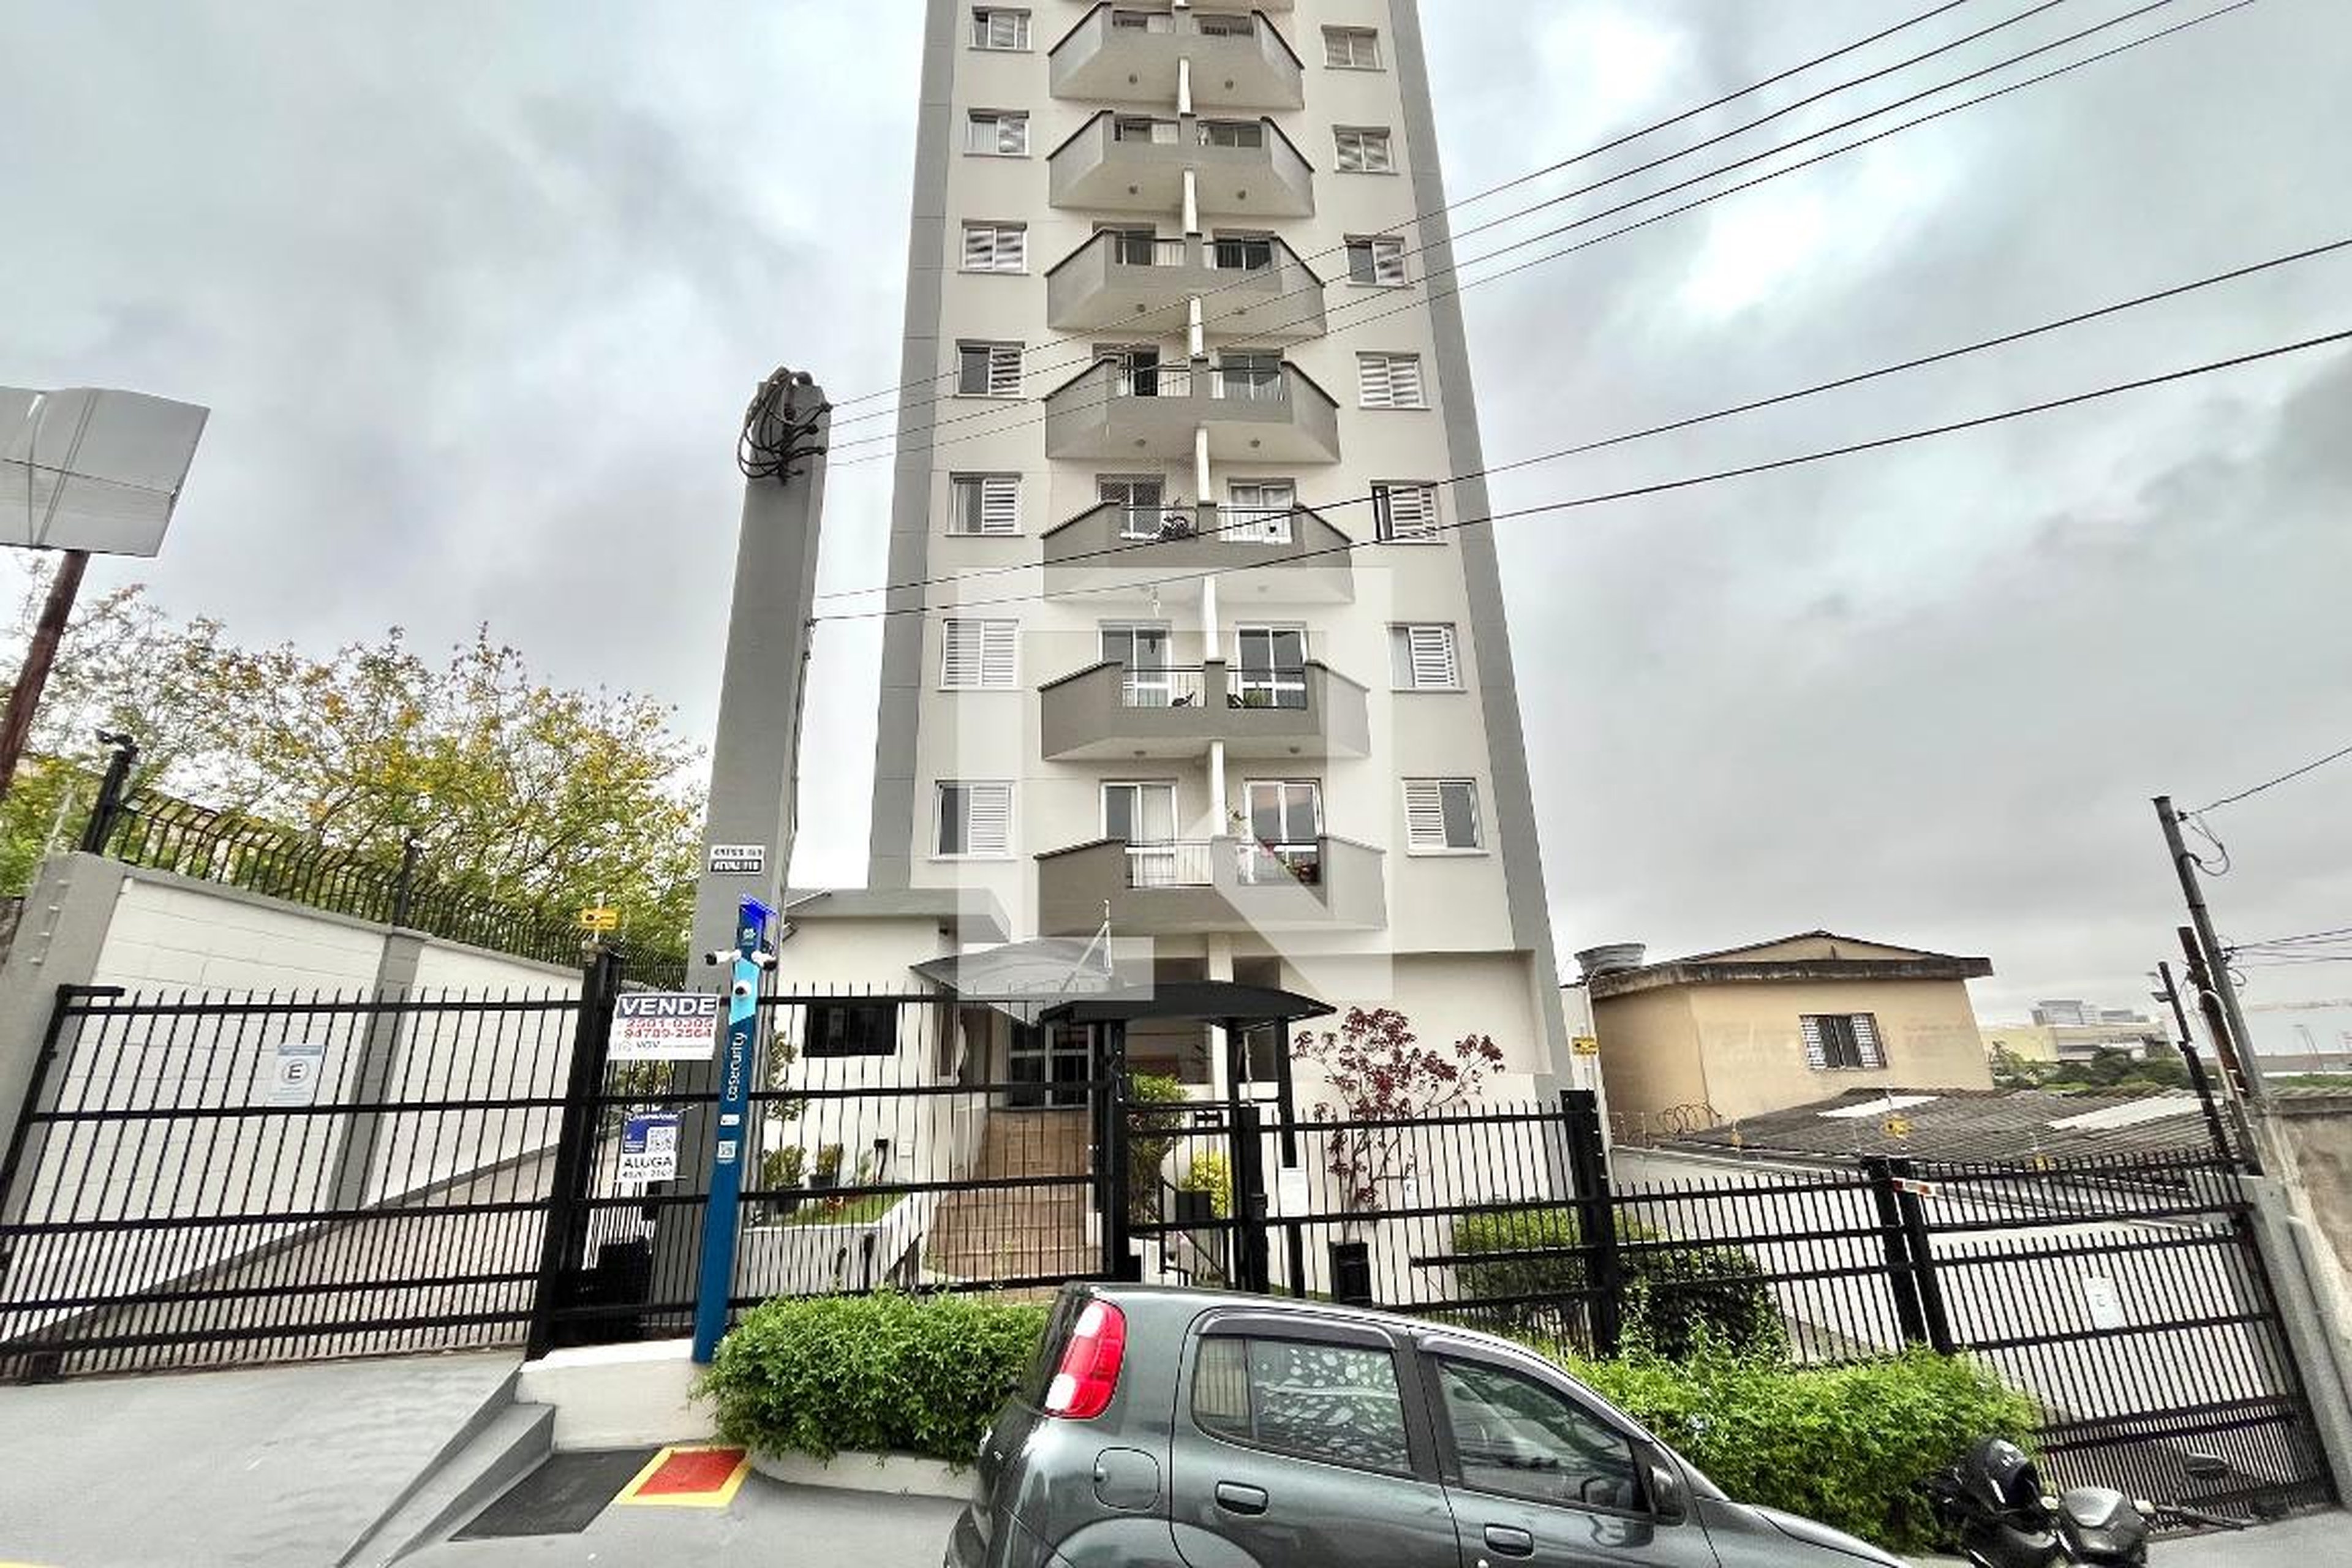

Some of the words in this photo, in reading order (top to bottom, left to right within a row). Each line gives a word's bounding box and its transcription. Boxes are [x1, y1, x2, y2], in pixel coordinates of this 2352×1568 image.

[622, 997, 717, 1016] VENDE
[287, 1063, 303, 1079] E
[624, 1156, 673, 1169] ALUGA
